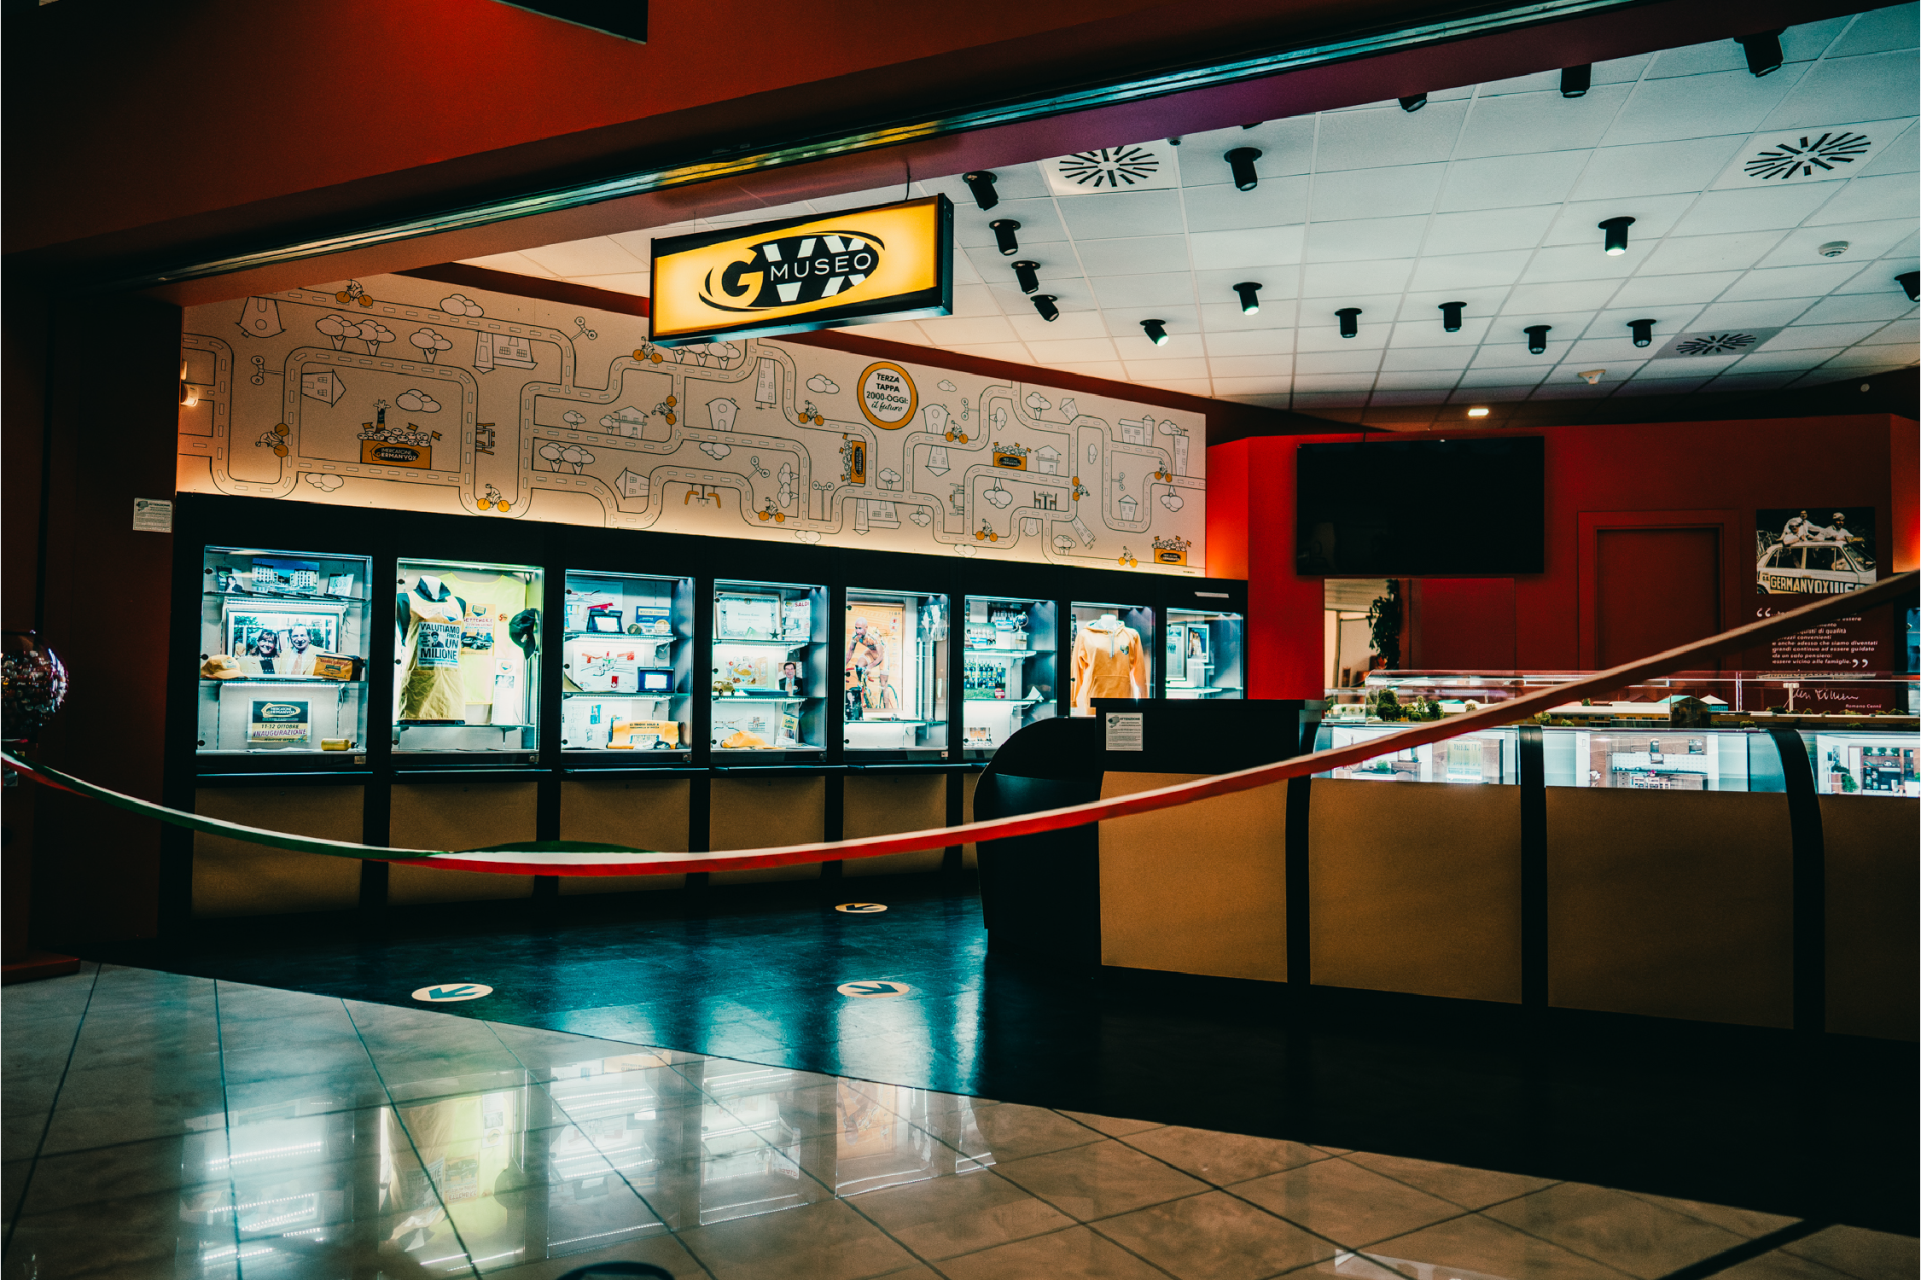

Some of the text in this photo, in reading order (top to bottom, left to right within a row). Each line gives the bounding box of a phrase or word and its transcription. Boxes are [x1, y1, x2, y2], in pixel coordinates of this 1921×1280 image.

[770, 252, 872, 282] MUSEO
[876, 373, 900, 383] TERZA
[876, 383, 900, 393] TAPPA
[871, 401, 903, 412] il futuro
[1770, 575, 1829, 594] GERMANVOX
[420, 623, 460, 635] VALUTIAMO
[445, 638, 459, 649] UN
[420, 647, 458, 660] MILIONE
[253, 728, 307, 737] INAUGURAZIONE
